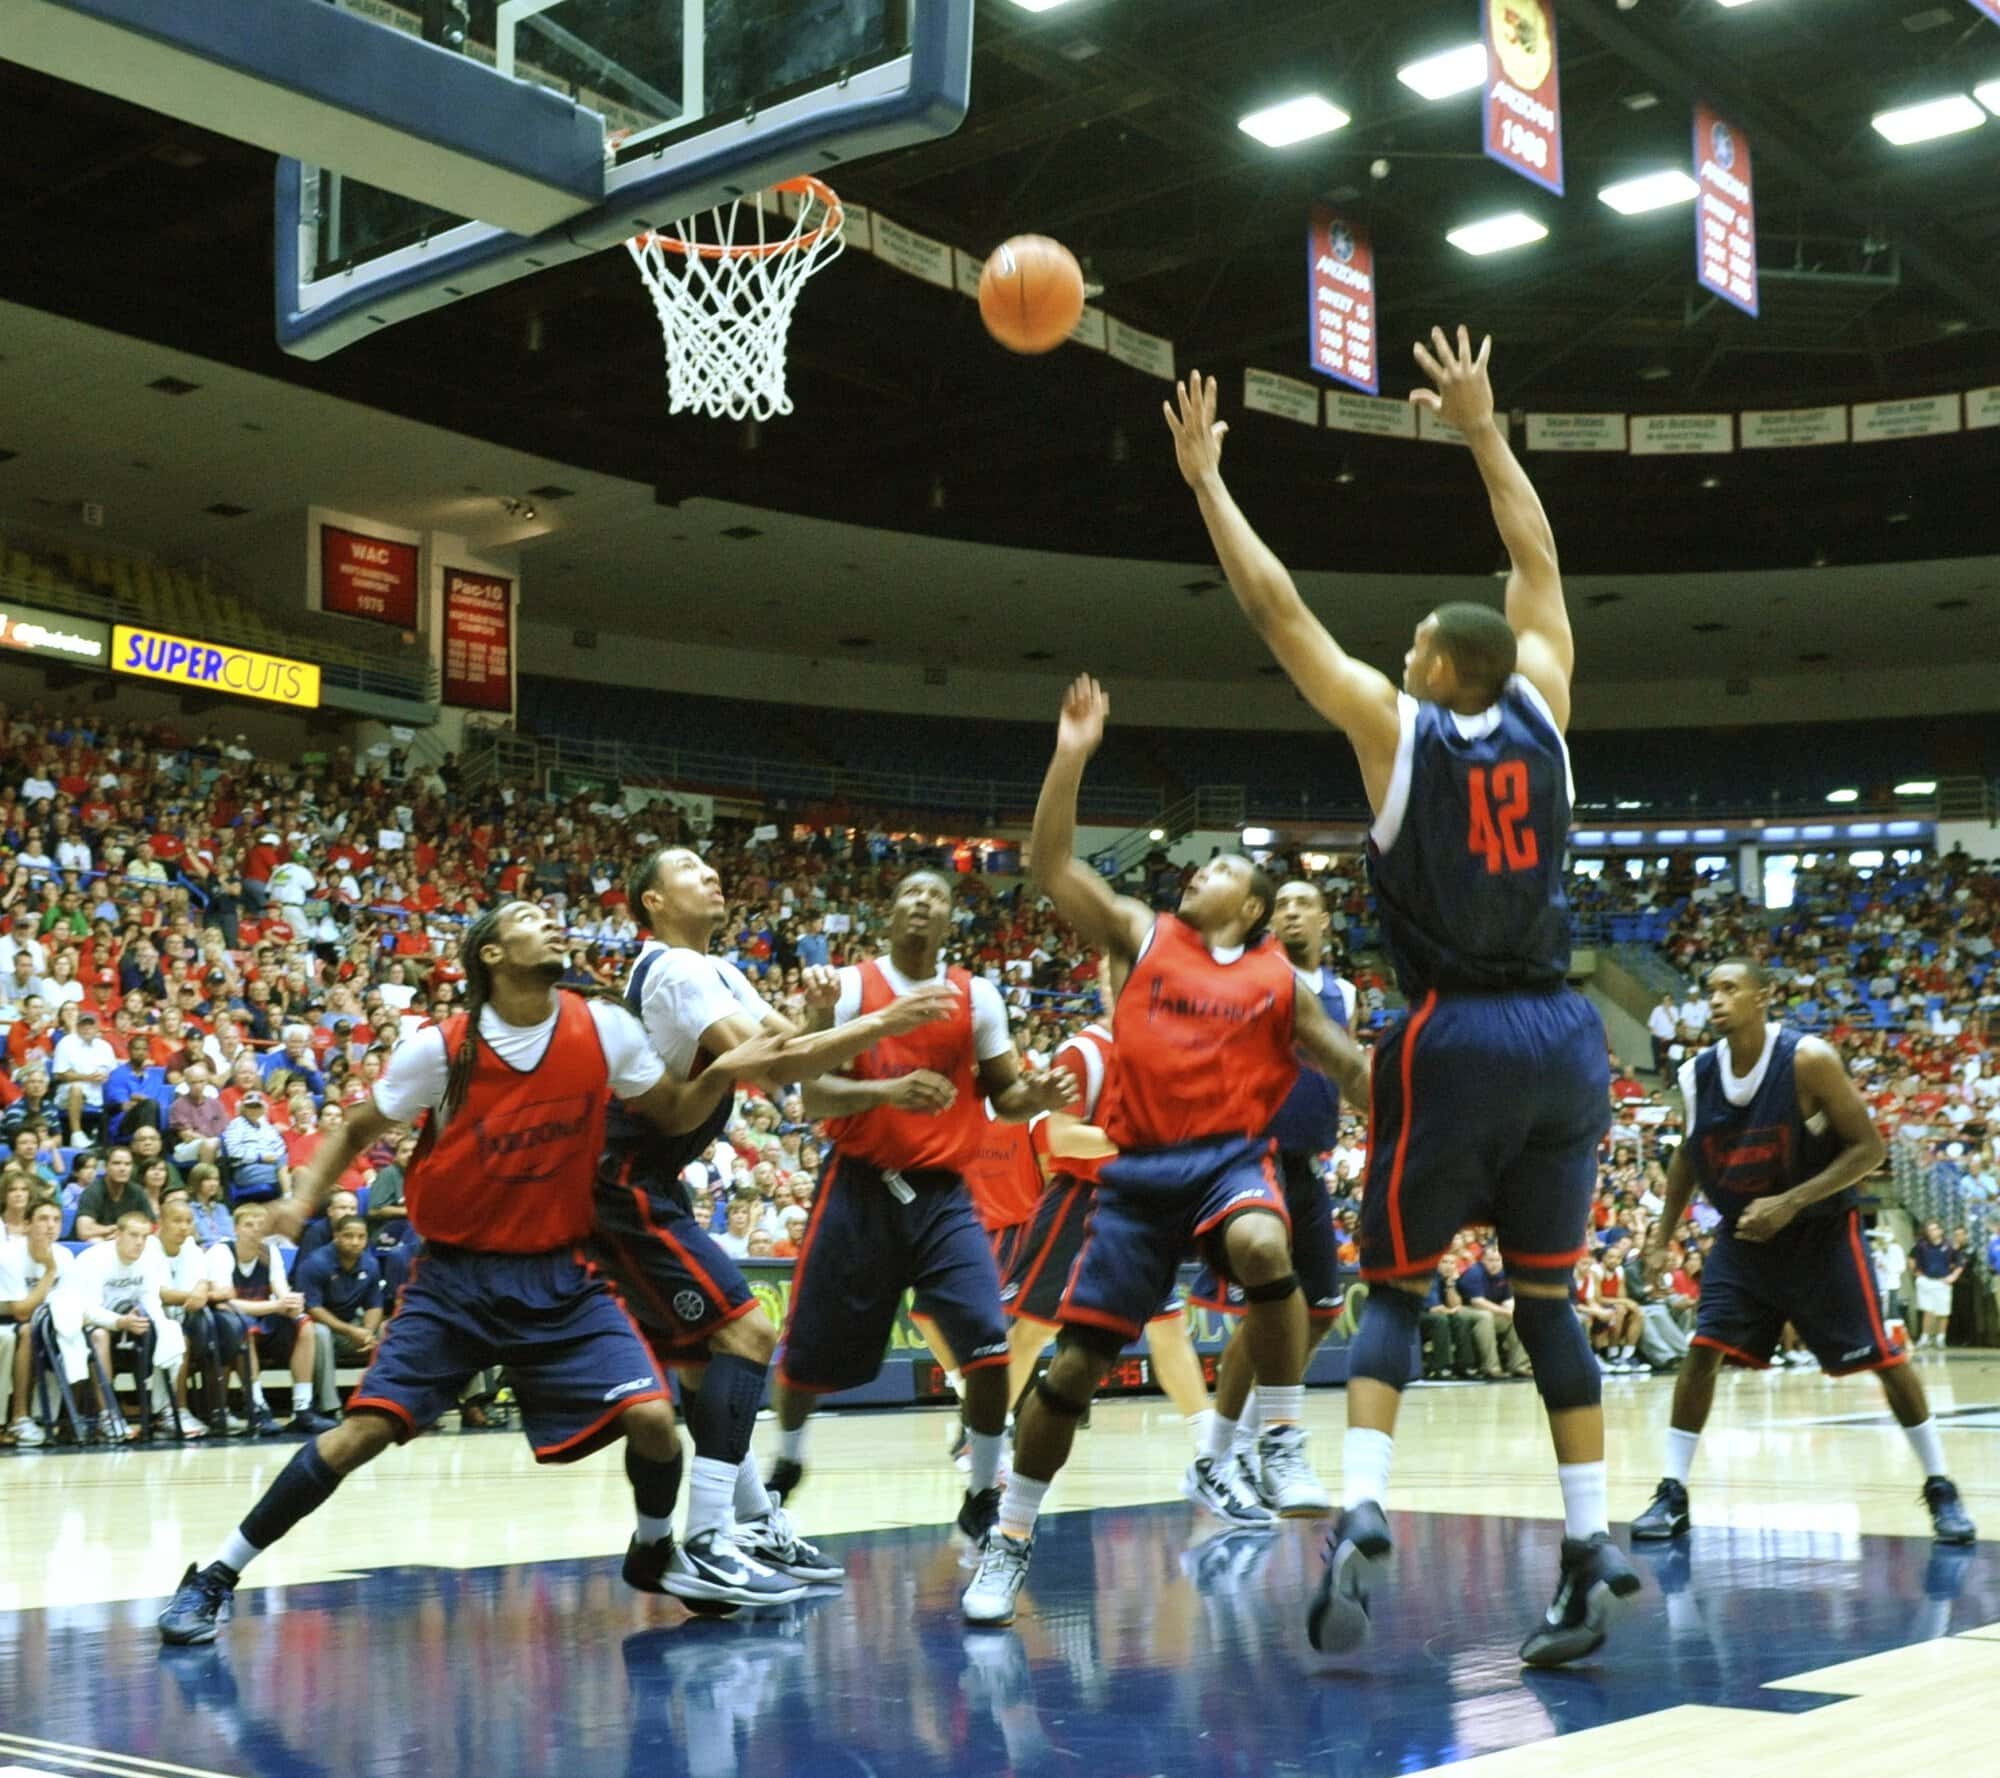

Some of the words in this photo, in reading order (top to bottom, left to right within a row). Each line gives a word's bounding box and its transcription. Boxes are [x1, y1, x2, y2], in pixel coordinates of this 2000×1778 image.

[351, 542, 390, 565] WAC
[451, 577, 503, 601] Pac-10
[125, 632, 303, 699] SUPERCUTS
[1467, 759, 1539, 875] 42
